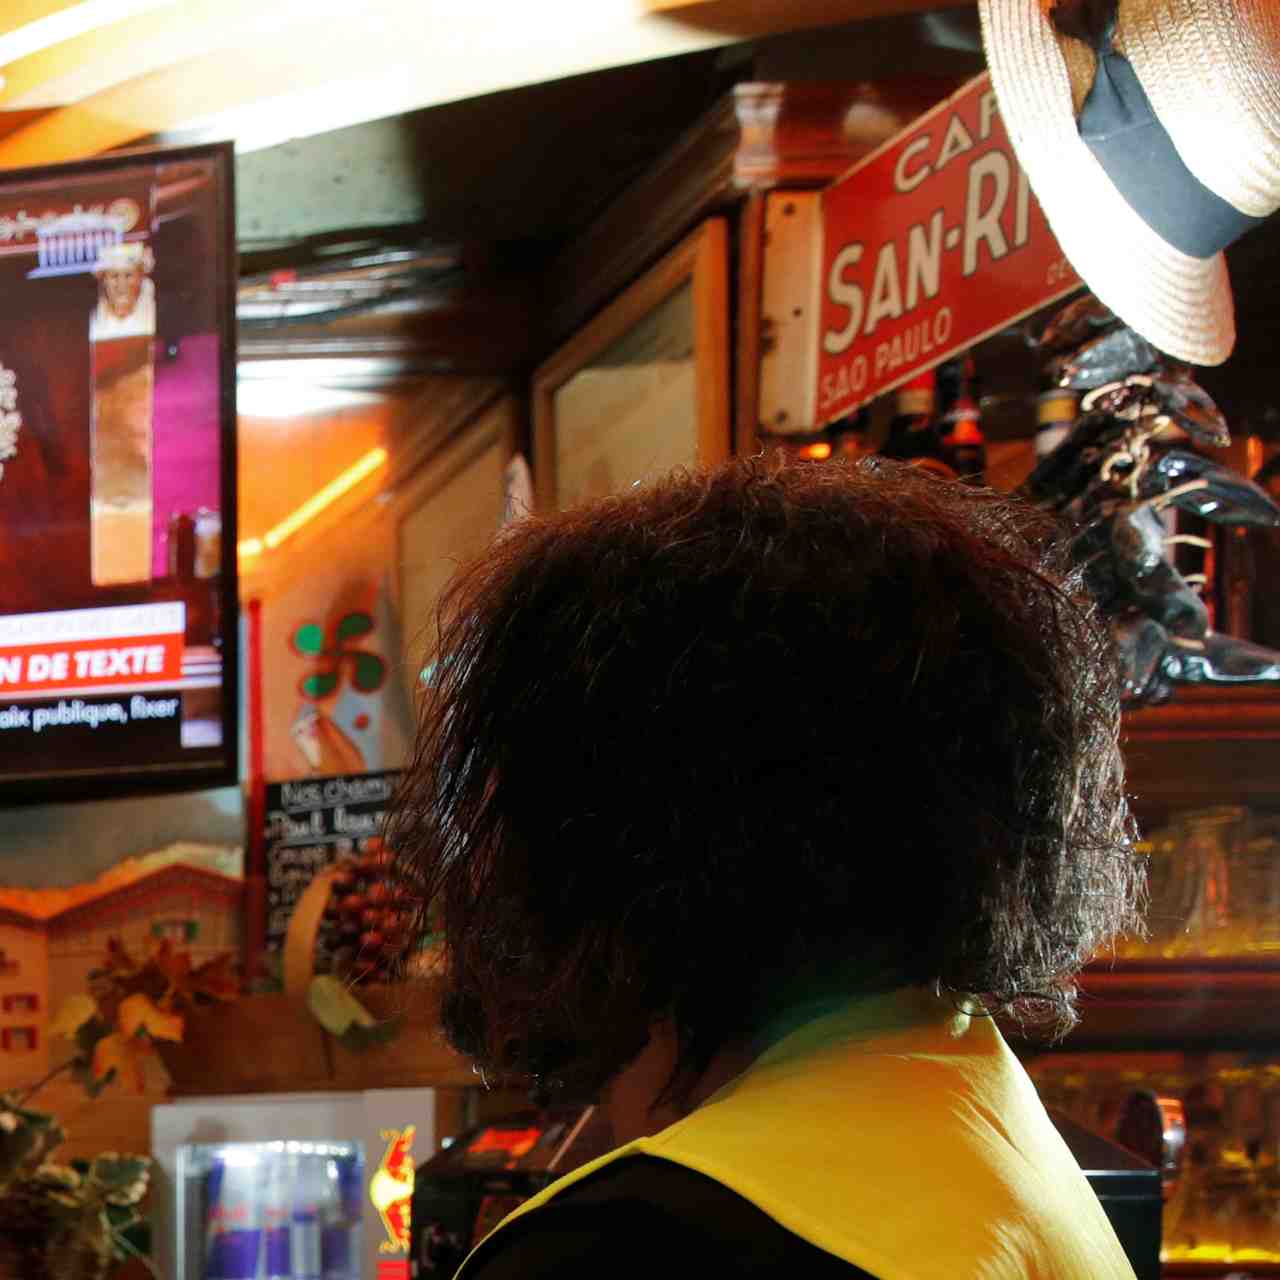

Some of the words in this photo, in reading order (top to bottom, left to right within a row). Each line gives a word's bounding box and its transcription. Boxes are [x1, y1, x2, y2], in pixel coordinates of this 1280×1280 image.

[824, 150, 1031, 354] SAN-RI
[874, 305, 953, 377] PAULO
[27, 651, 69, 683] DE
[73, 644, 166, 679] TEXTE
[32, 699, 129, 733] publique,
[130, 694, 180, 720] fixer
